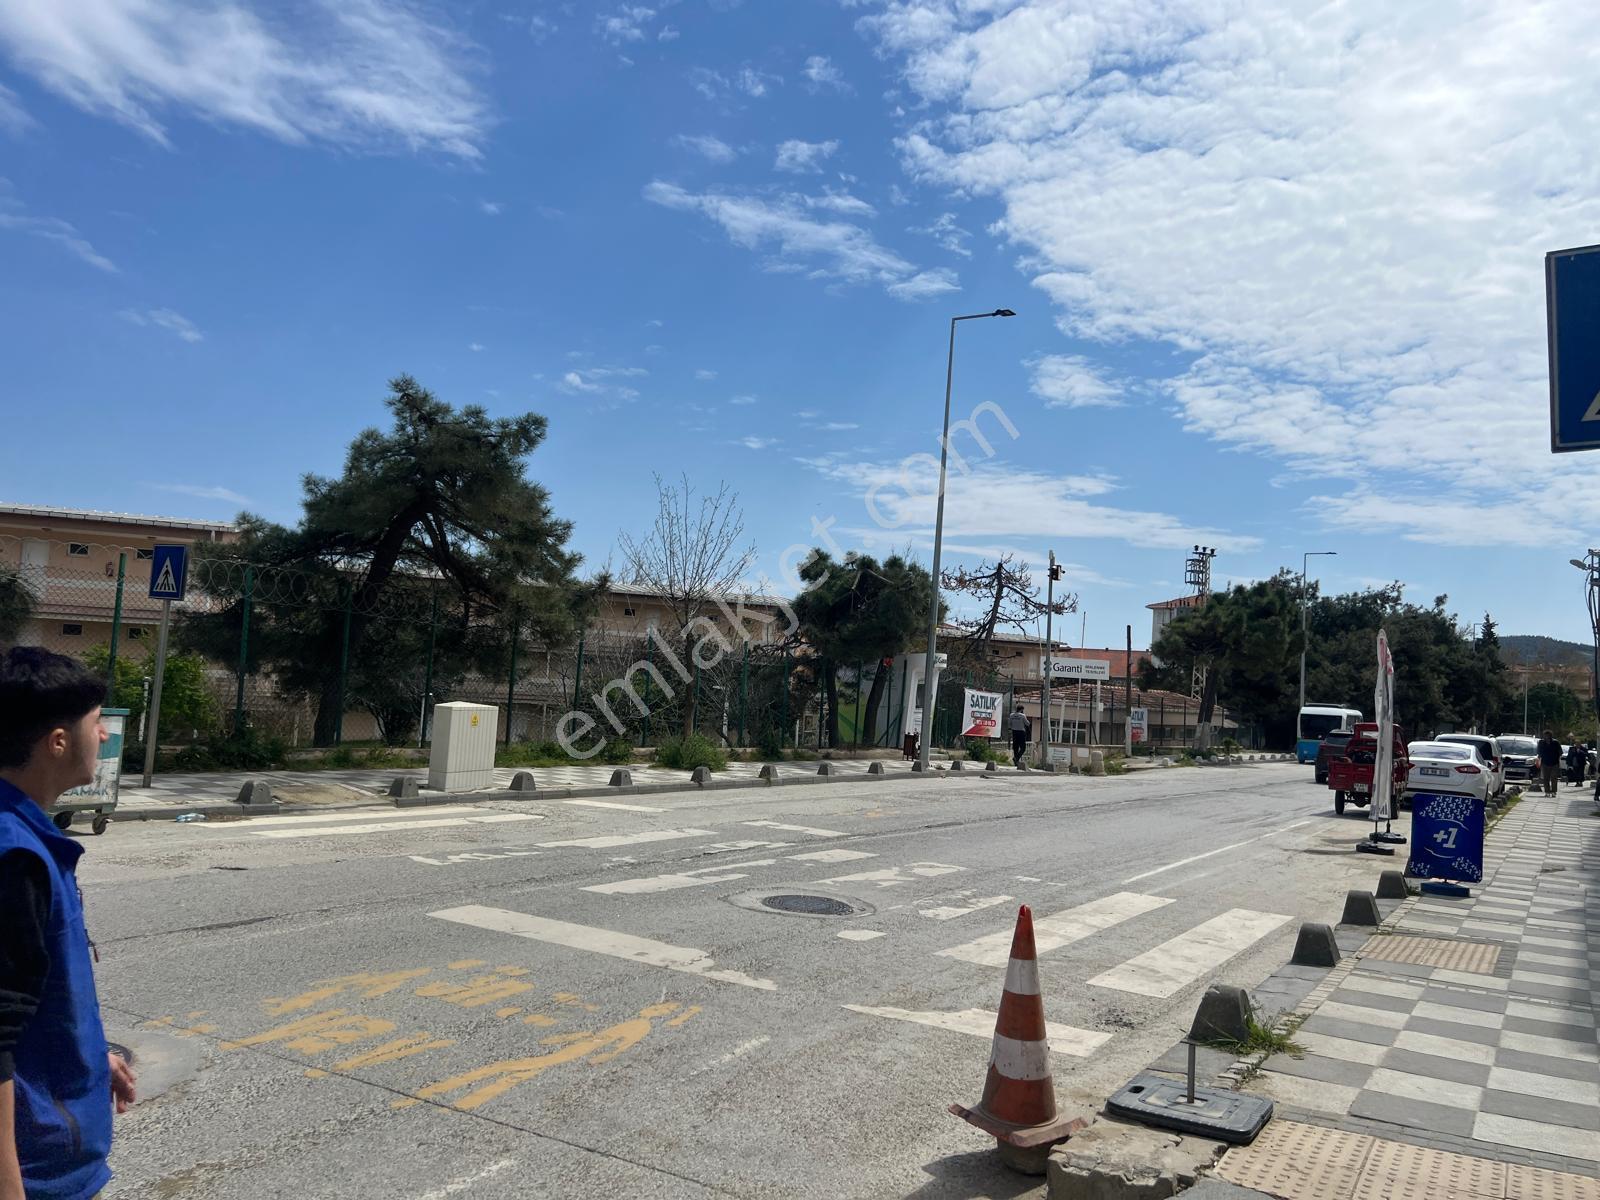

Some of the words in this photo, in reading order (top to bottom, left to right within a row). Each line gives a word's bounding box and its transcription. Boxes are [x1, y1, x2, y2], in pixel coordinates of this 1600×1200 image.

[1053, 662, 1083, 674] Garanti
[970, 694, 997, 711] SATILIK
[1131, 710, 1144, 721] ATILIK
[1433, 827, 1458, 849] +1
